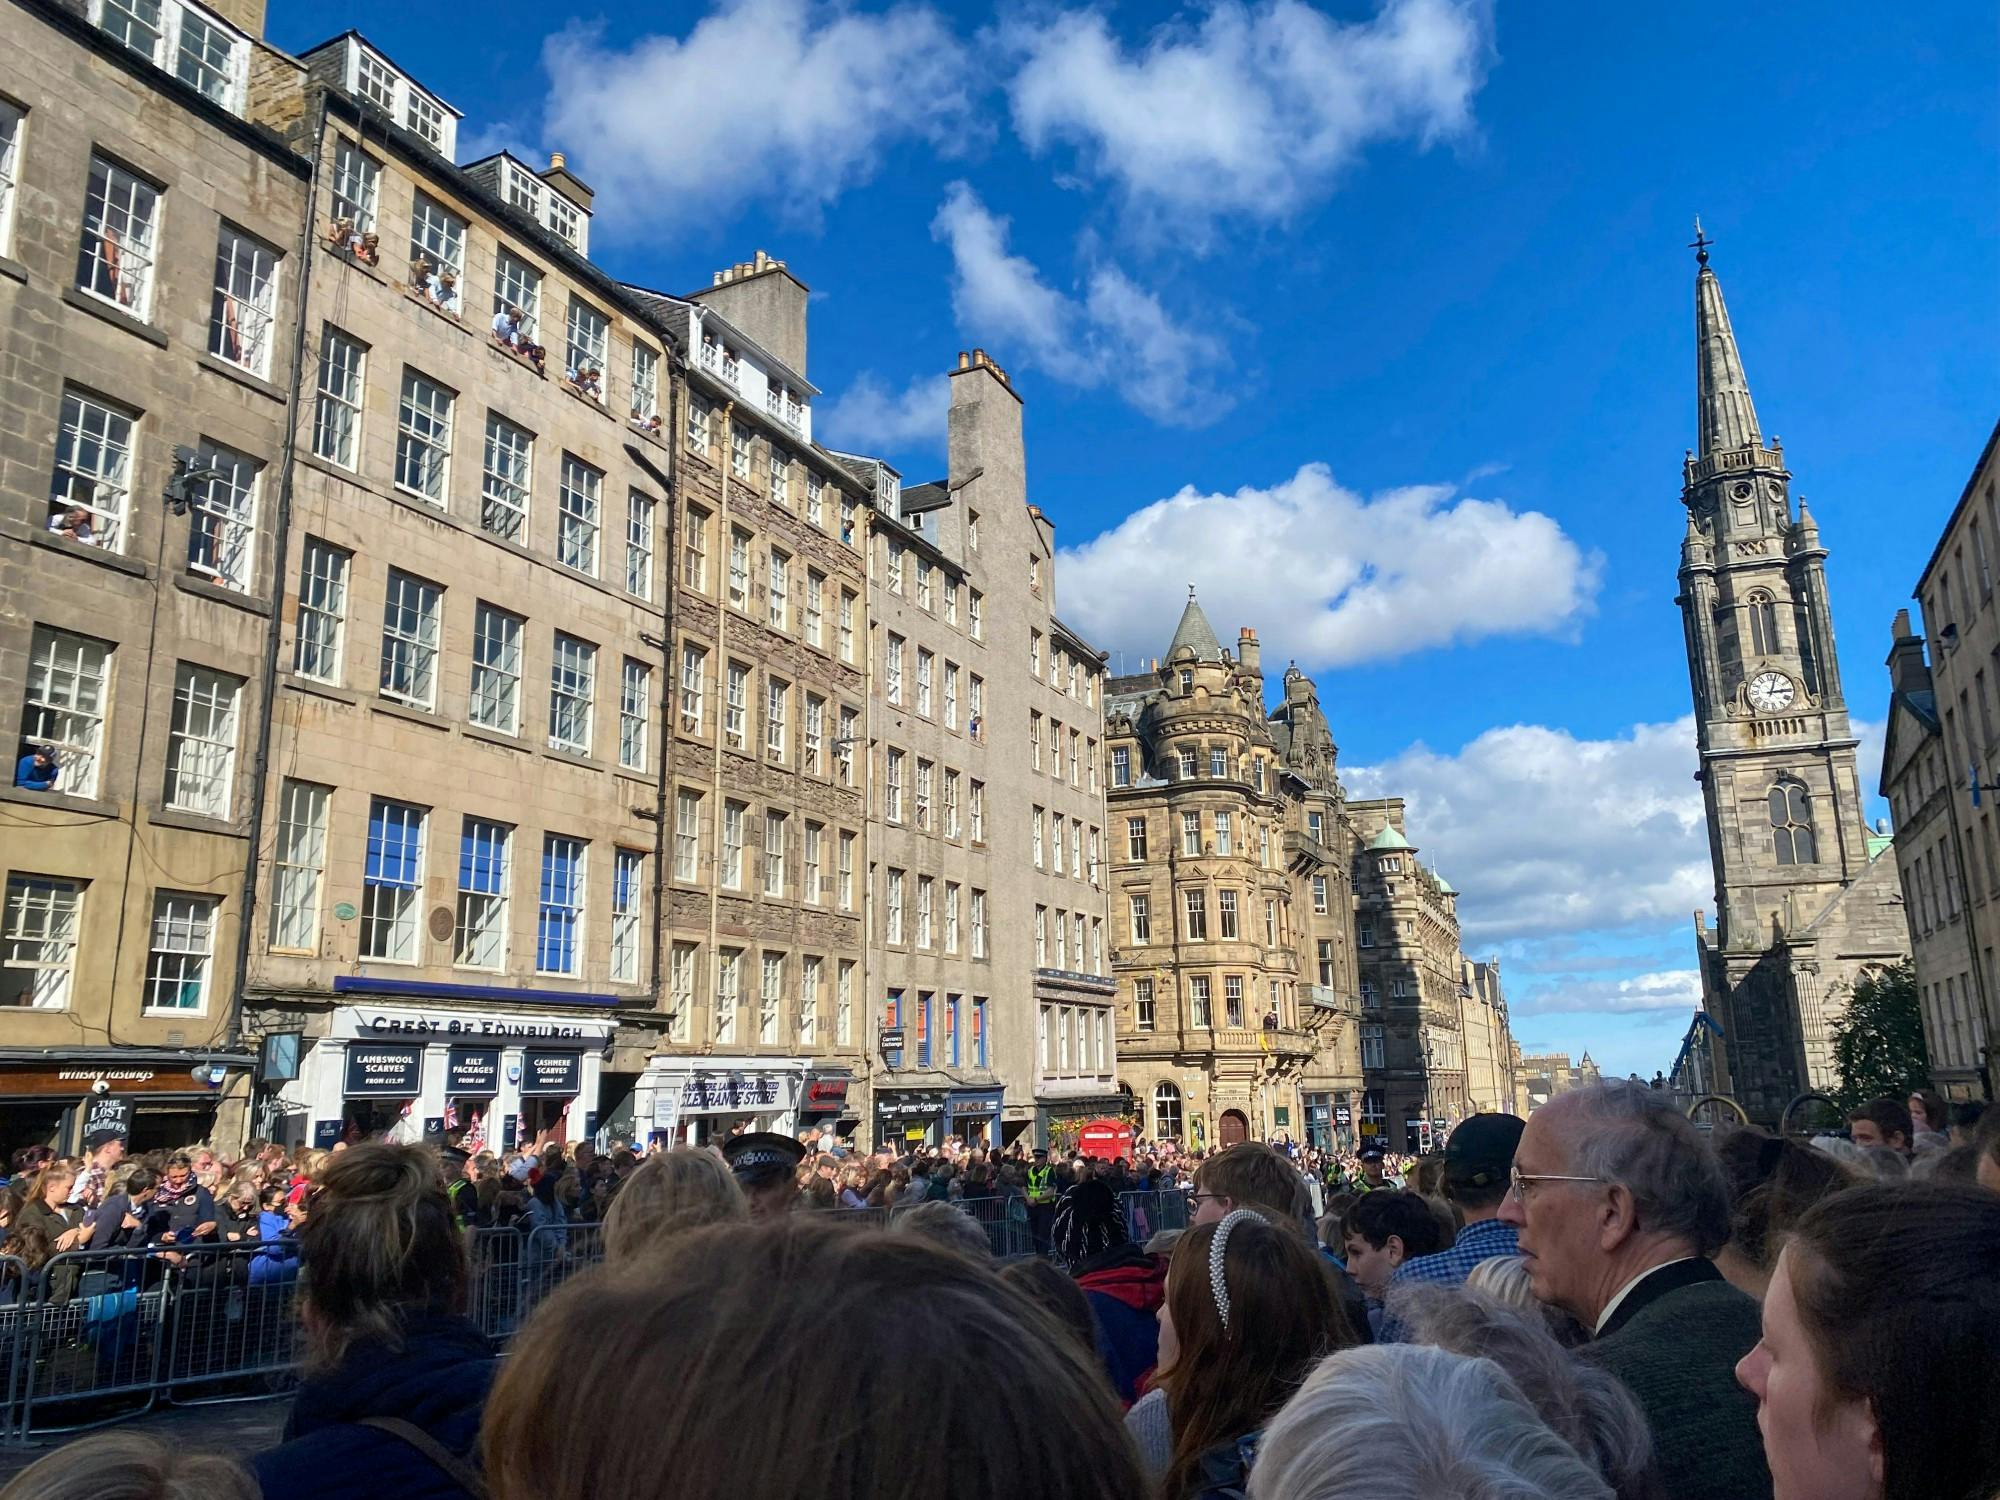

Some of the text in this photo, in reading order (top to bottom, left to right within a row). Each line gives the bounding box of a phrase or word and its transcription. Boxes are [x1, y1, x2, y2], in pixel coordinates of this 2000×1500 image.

[372, 1016, 583, 1040] CREST OF EDINBURGH
[356, 1055, 414, 1063] LAMBSWOOL
[365, 1064, 405, 1072] SCARVES
[453, 1066, 494, 1074] PACKAGES
[680, 1090, 778, 1108] CLEARANCE STORE
[90, 1106, 127, 1122] LOST
